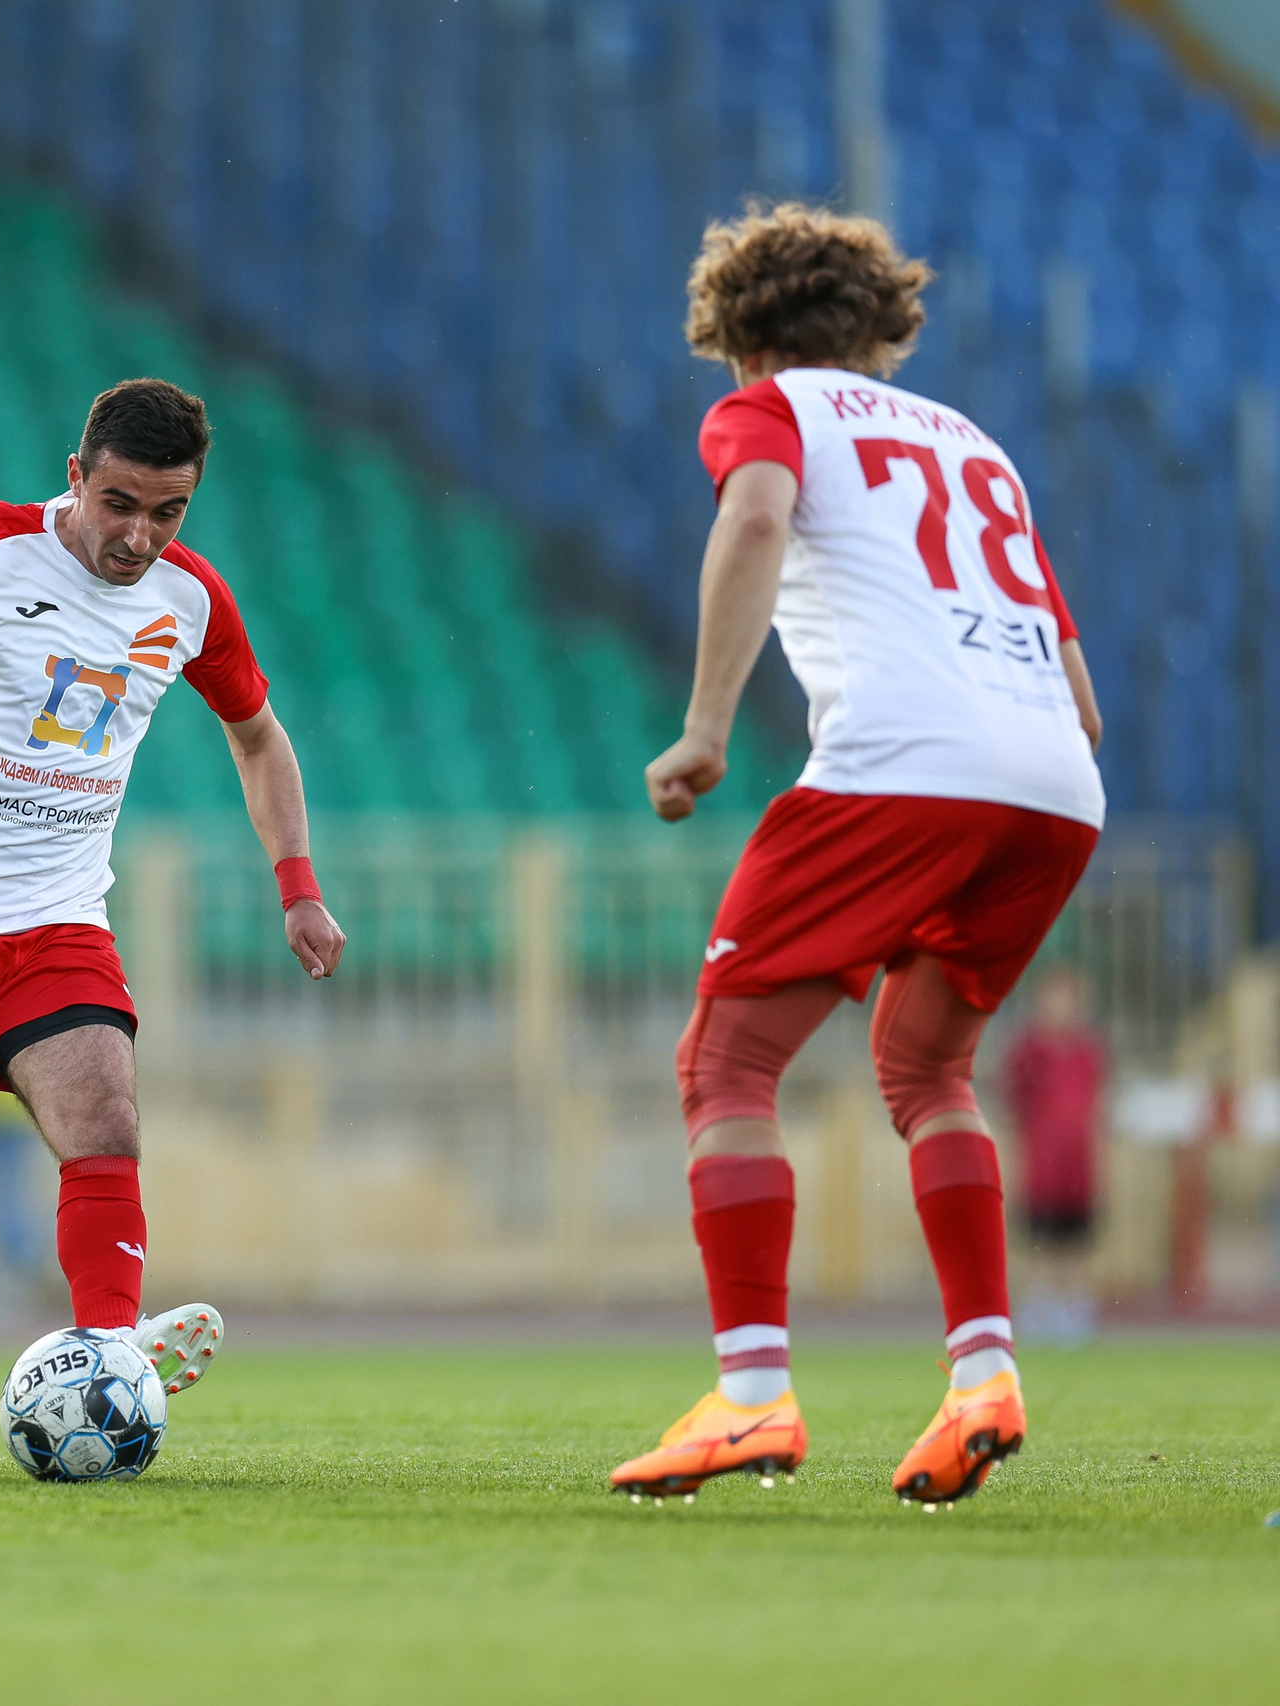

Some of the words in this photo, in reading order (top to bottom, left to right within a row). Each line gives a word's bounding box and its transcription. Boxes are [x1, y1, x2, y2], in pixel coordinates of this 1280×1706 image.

[822, 390, 1000, 445] КРАЧИН
[851, 438, 1056, 611] 78
[40, 773, 51, 787] и
[50, 769, 94, 794] боремся
[95, 779, 121, 794] вместе
[12, 1349, 89, 1405] SELECT
